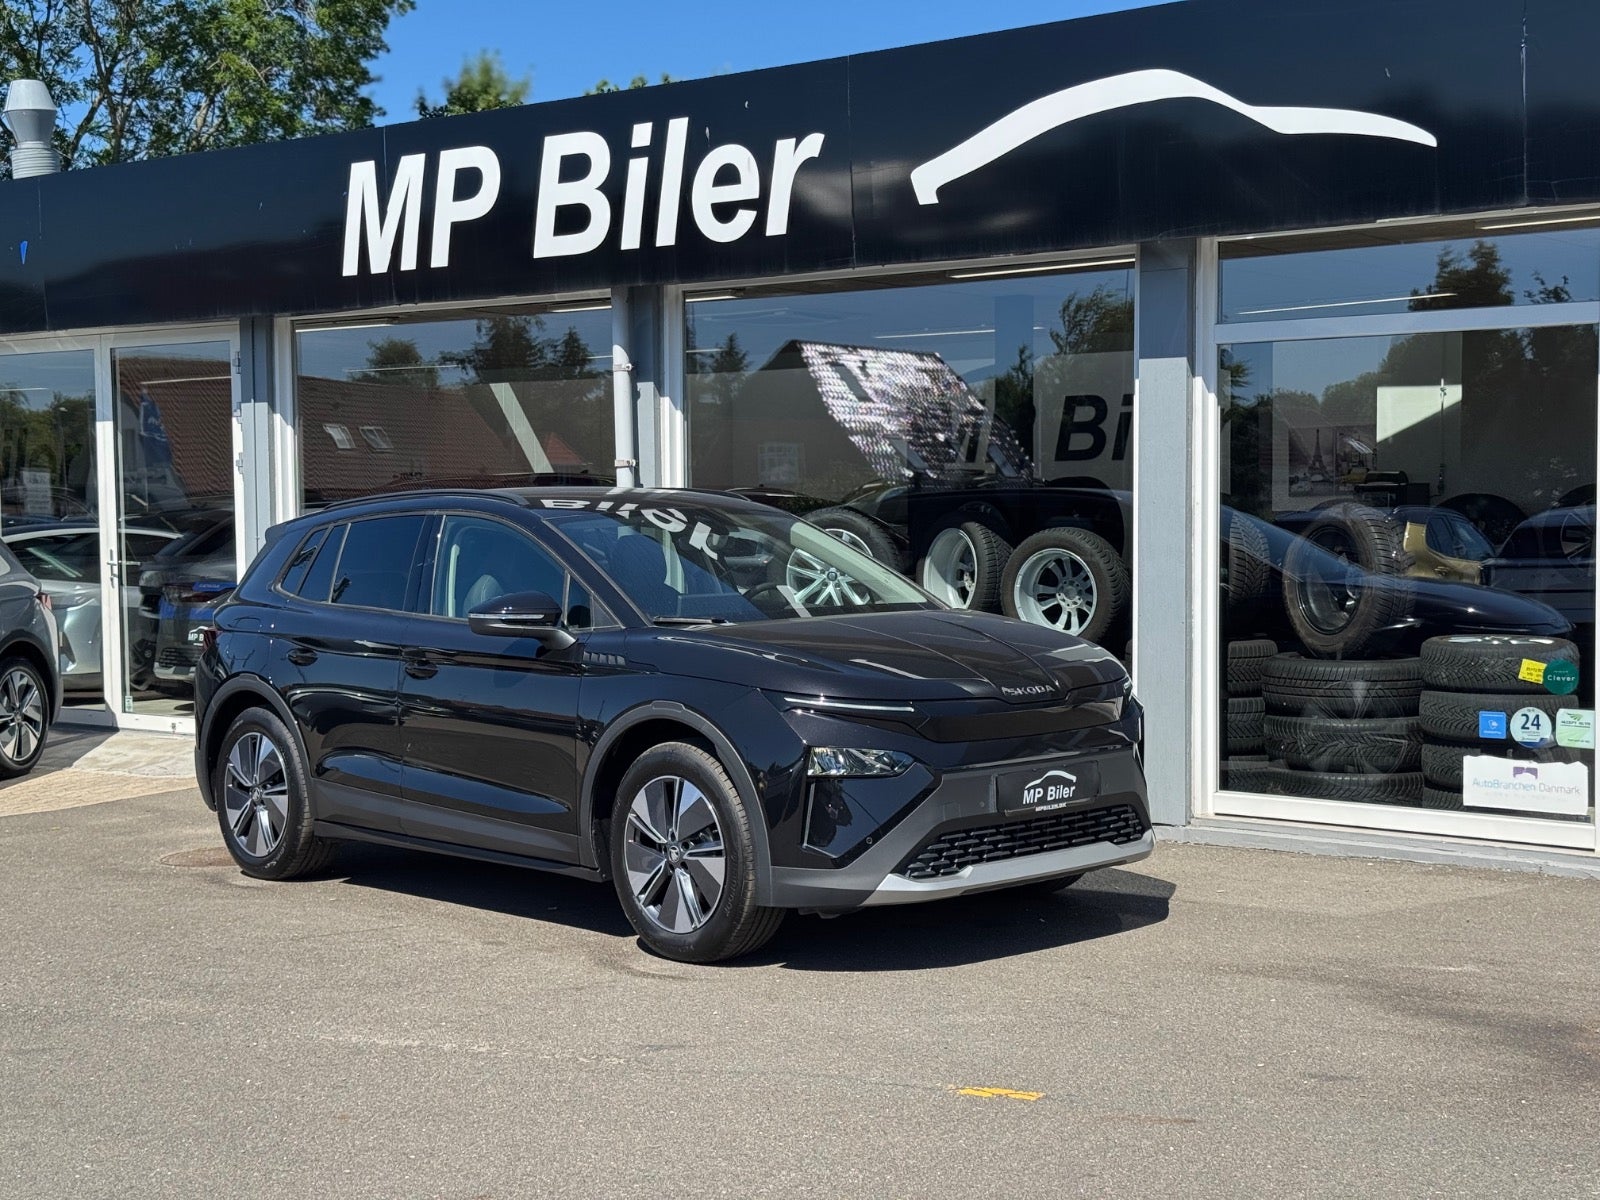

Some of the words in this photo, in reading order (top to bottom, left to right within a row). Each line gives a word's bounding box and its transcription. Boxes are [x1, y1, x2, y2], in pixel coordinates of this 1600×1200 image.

[341, 145, 501, 277] MP
[532, 116, 826, 259] Biler
[1546, 674, 1576, 682] Clever
[1520, 713, 1542, 731] 24
[1022, 787, 1044, 805] MP
[1046, 784, 1076, 801] Biler
[1472, 777, 1536, 792] AutoBranchen
[1538, 782, 1581, 795] Danmark
